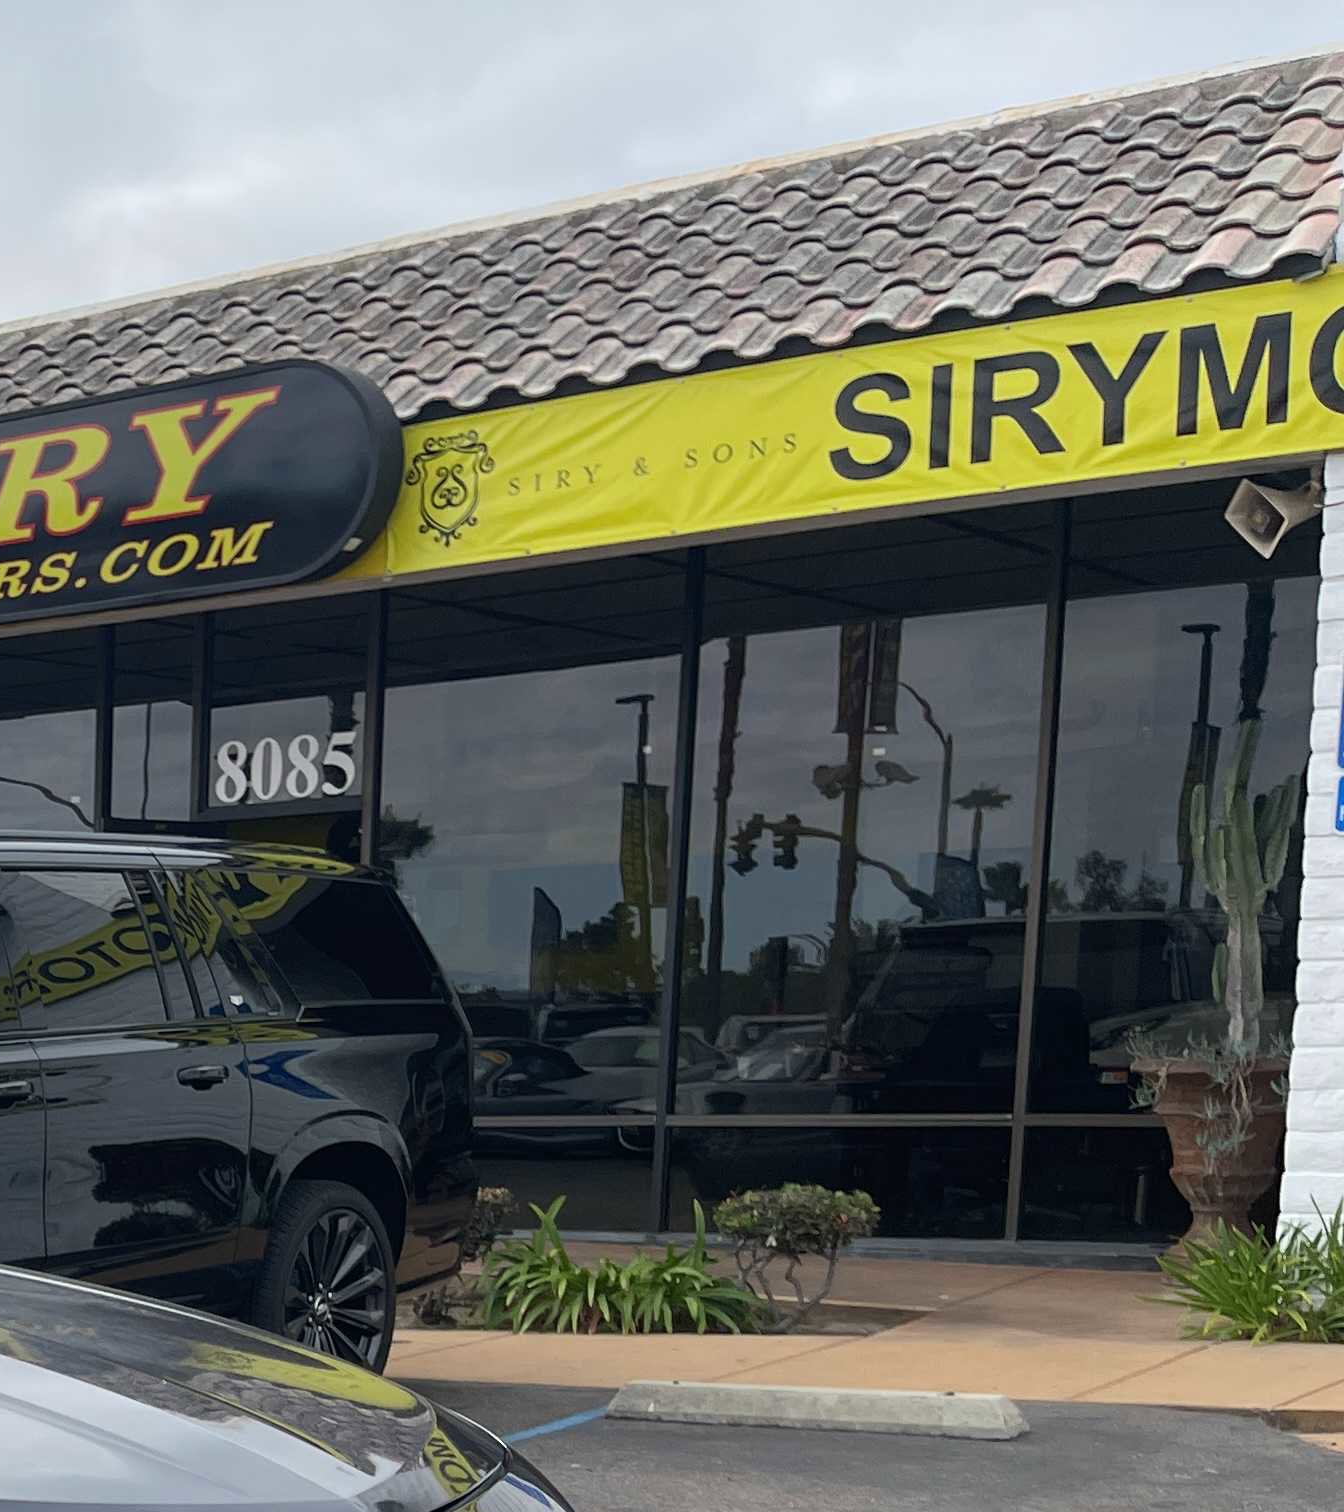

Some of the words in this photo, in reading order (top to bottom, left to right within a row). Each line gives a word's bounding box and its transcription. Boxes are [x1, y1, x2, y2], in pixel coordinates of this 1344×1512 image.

[507, 463, 601, 497] SIRY
[633, 456, 650, 477] &
[684, 433, 798, 469] SONS
[215, 731, 358, 803] 8085
